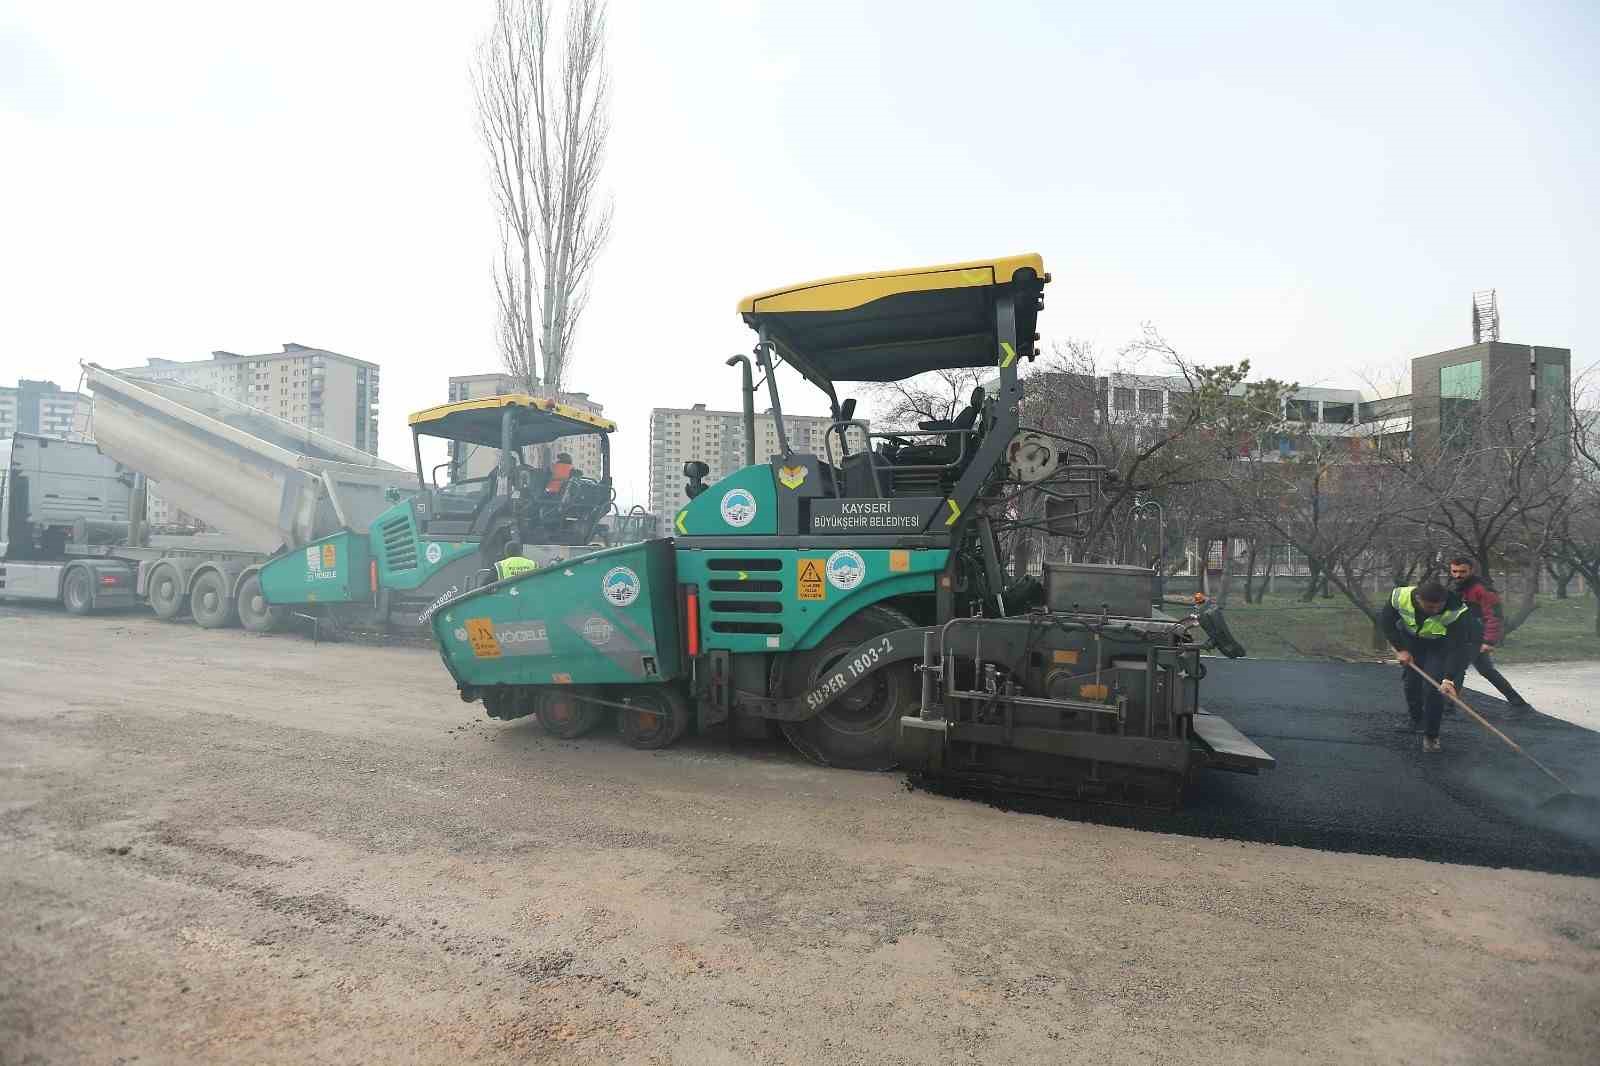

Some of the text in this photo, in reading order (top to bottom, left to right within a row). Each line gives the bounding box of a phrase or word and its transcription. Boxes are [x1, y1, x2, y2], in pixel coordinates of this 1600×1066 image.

[841, 501, 891, 514] KAYSERİ
[814, 515, 868, 530] BÜYÜKŞEHİR
[807, 638, 894, 710] SUPER 1803-2
